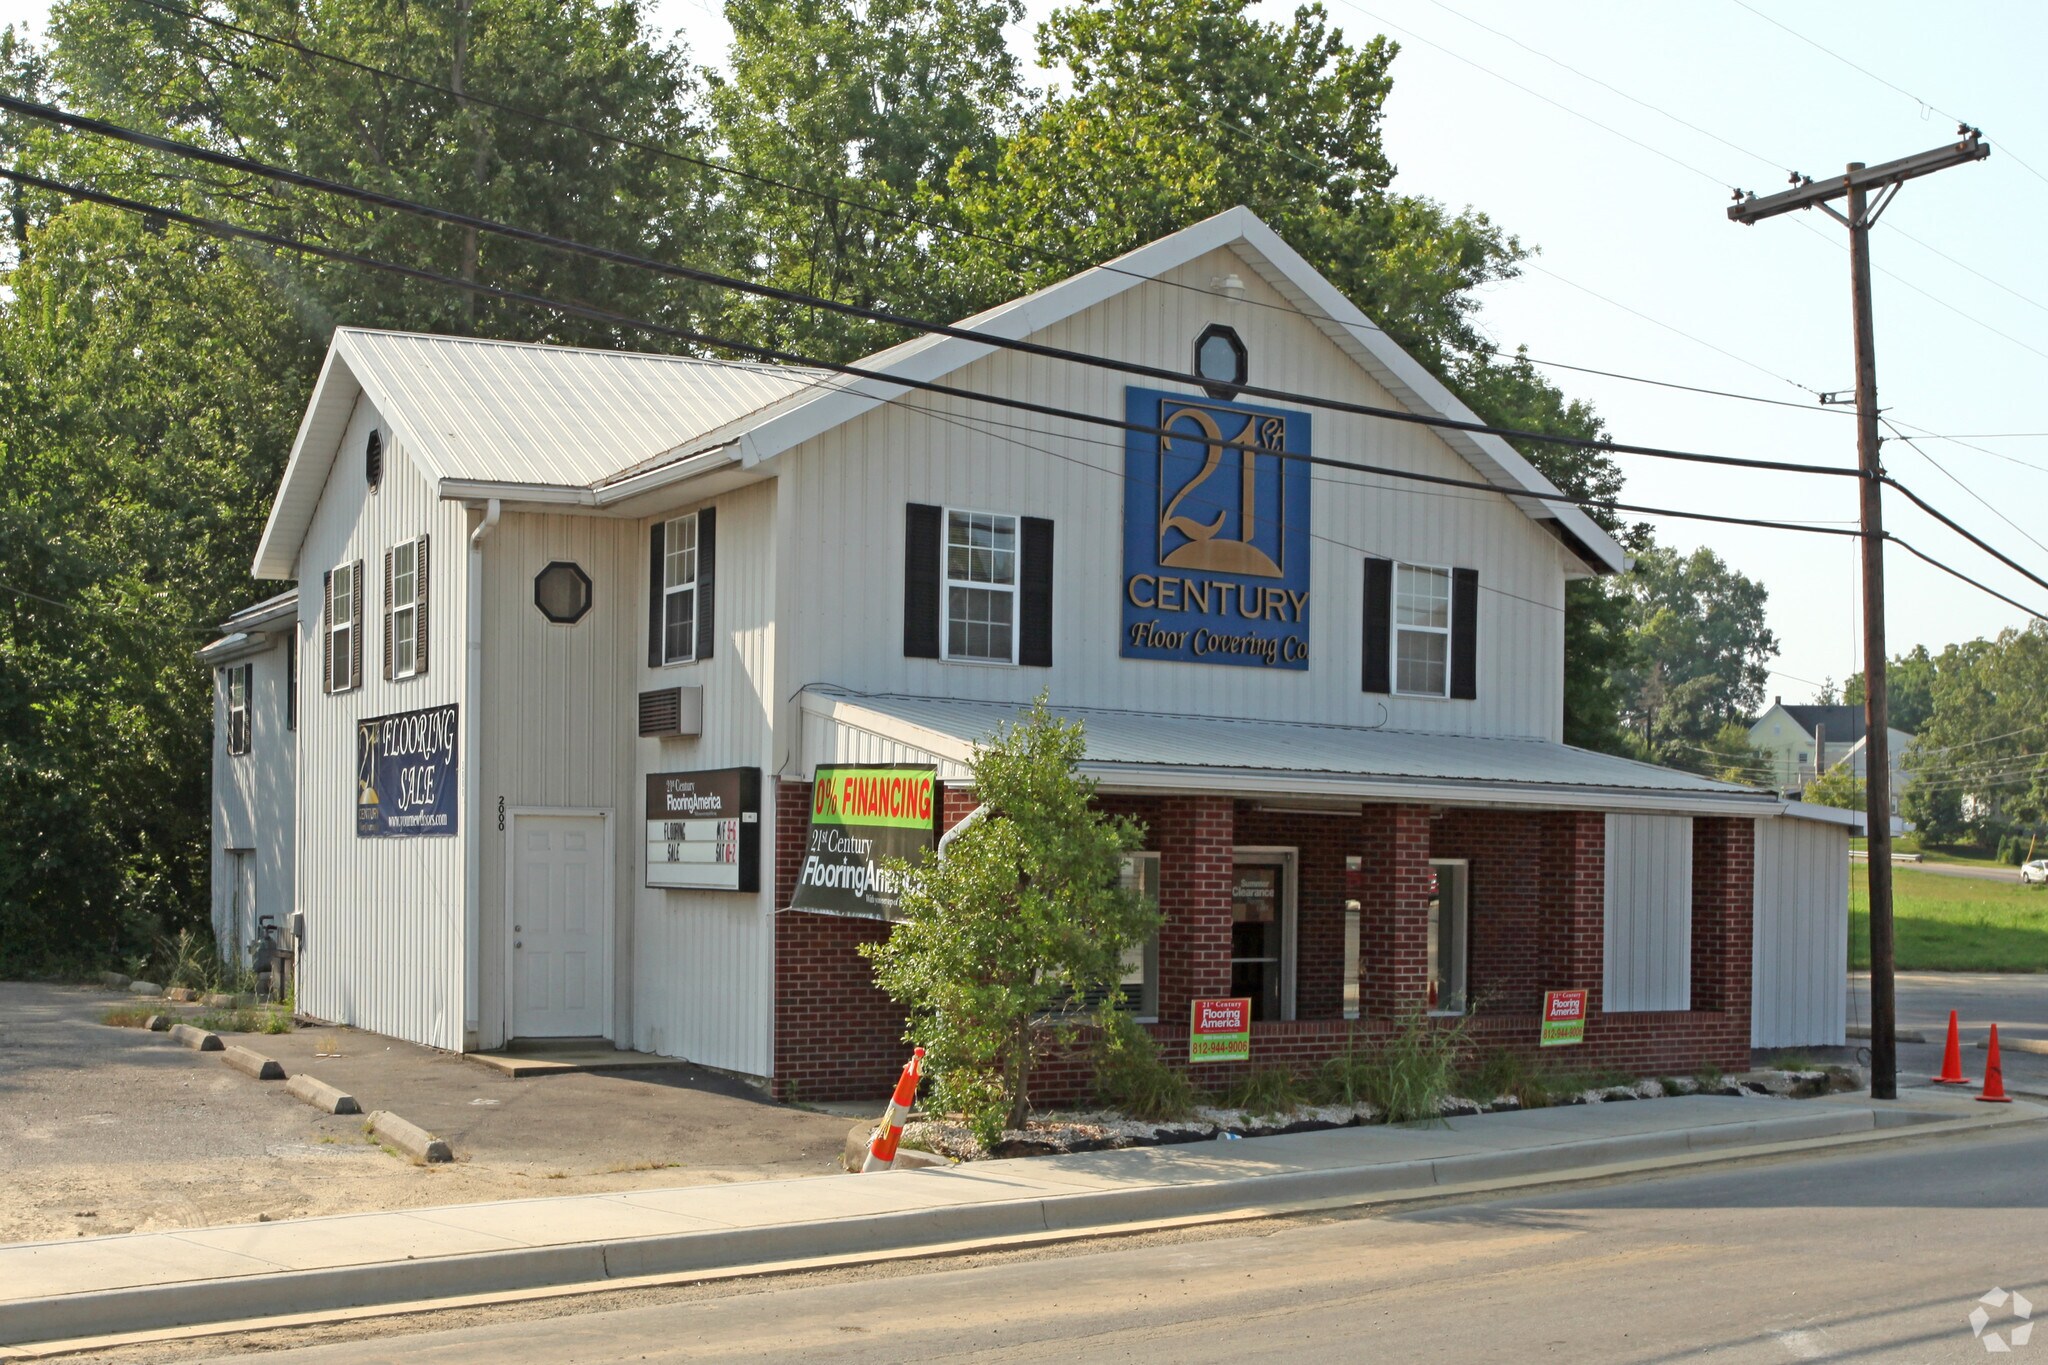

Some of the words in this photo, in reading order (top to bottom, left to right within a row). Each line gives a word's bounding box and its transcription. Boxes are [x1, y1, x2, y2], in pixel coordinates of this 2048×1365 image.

[1128, 573, 1310, 622] CENTURY
[1131, 620, 1187, 650] Floor
[1193, 627, 1278, 664] Covering
[382, 709, 455, 765] FLOORING
[398, 765, 435, 811] SALE
[675, 778, 695, 795] Century
[815, 776, 838, 817] 0%
[841, 776, 932, 820] FINANCING
[664, 822, 686, 841] FLOORING
[667, 842, 680, 862] SALE
[716, 842, 725, 862] SAT
[810, 829, 828, 853] 21st
[828, 829, 873, 861] Century
[801, 855, 927, 898] FlooringAmerc
[1240, 879, 1270, 888] Summer
[1232, 886, 1275, 898] Clearance
[1215, 1000, 1242, 1008] Century
[1551, 1007, 1579, 1016] America
[1553, 999, 1579, 1008] Flooring
[1200, 1017, 1241, 1029] America
[1202, 1008, 1241, 1020] Flooring
[1192, 1040, 1248, 1055] 812-944-9006
